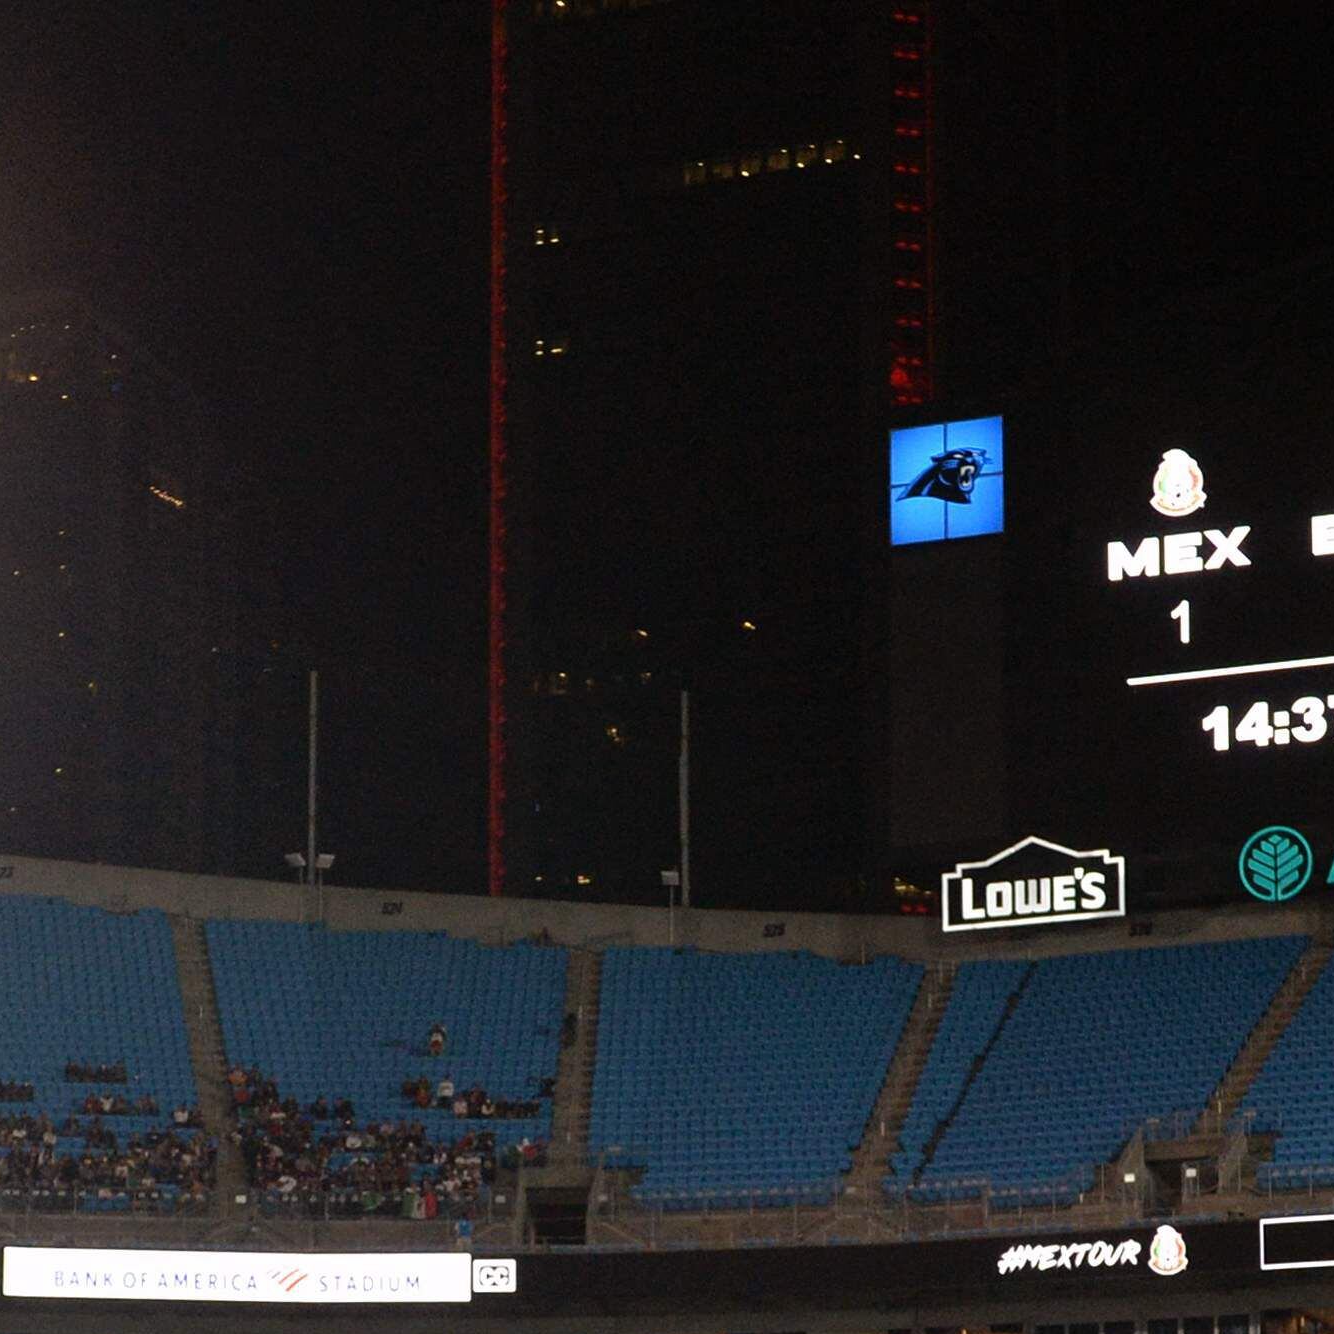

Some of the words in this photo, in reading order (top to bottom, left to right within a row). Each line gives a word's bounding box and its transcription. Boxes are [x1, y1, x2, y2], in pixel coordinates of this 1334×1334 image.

[1107, 525, 1252, 582] MEX
[1170, 599, 1190, 644] 1
[961, 866, 1108, 921] LOWE'S
[997, 1239, 1142, 1275] #MEXTOUR
[54, 1270, 114, 1289] BANK
[123, 1272, 148, 1289] OF
[157, 1273, 259, 1291] AMERICA
[319, 1275, 421, 1292] STADIUM
